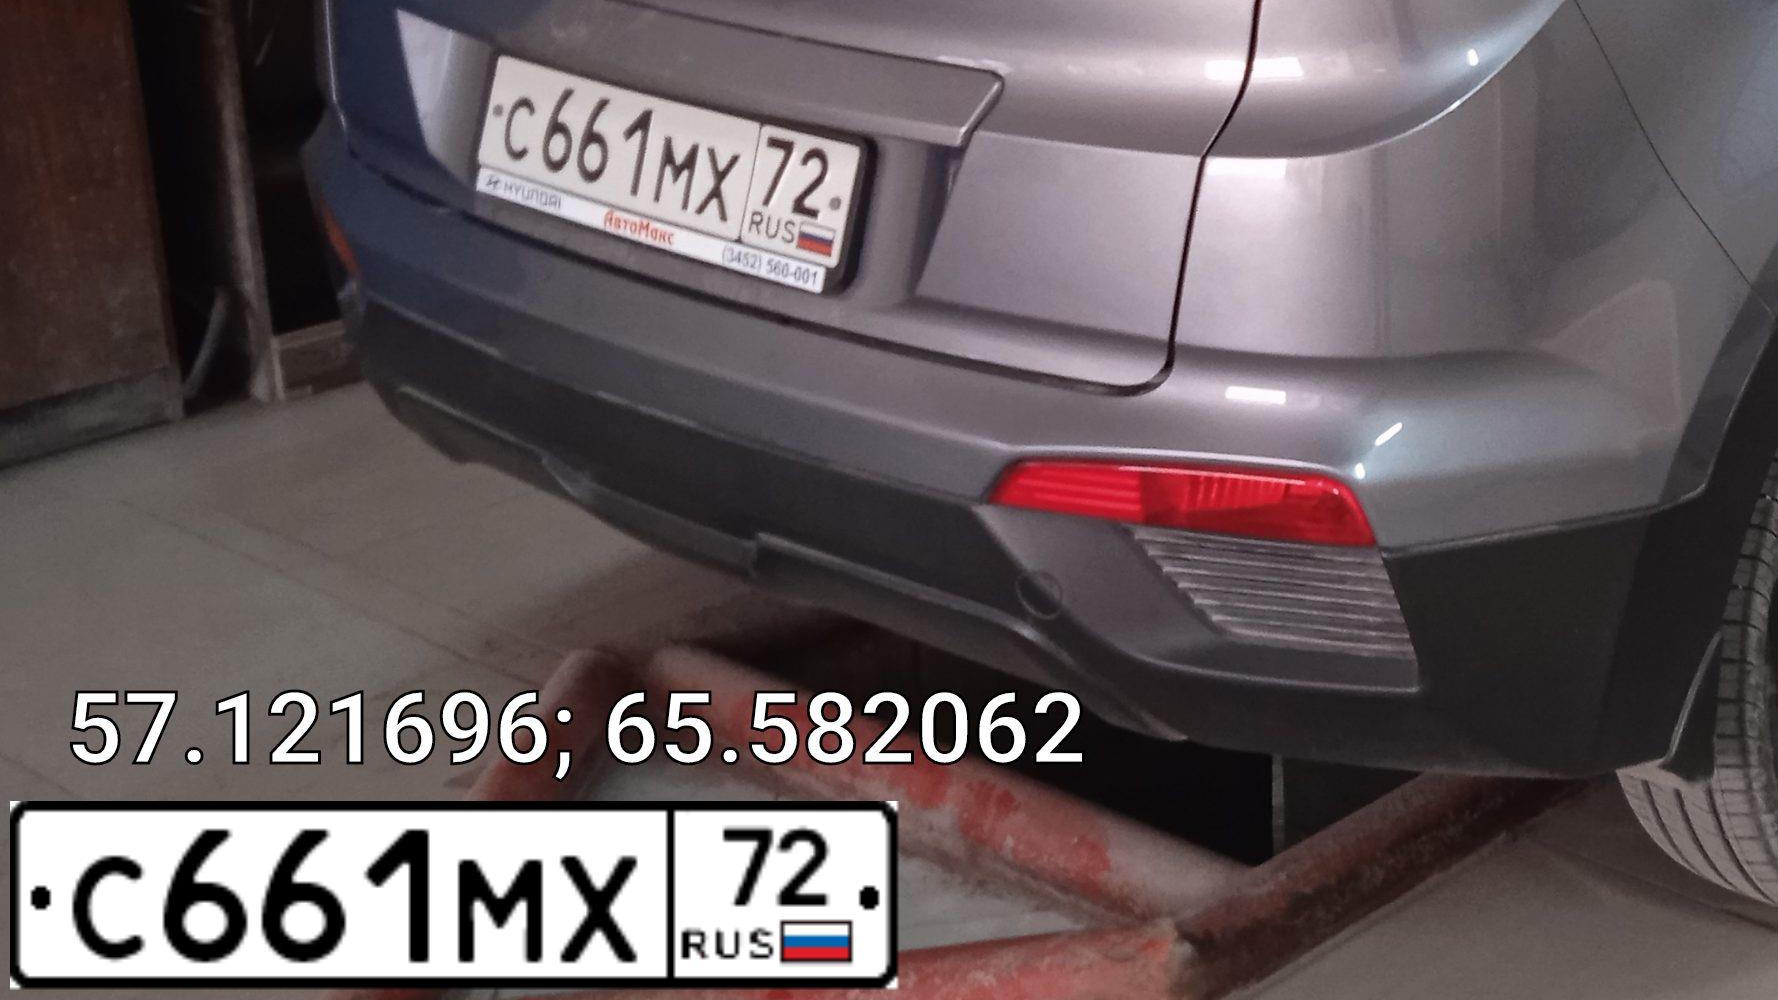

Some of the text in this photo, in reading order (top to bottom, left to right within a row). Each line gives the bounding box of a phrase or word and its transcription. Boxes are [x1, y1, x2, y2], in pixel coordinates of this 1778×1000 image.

[503, 87, 829, 222] С661МХ 72
[503, 181, 562, 210] HYUNDAI
[748, 210, 797, 244] RUS
[721, 246, 818, 286] (3452) 560-001
